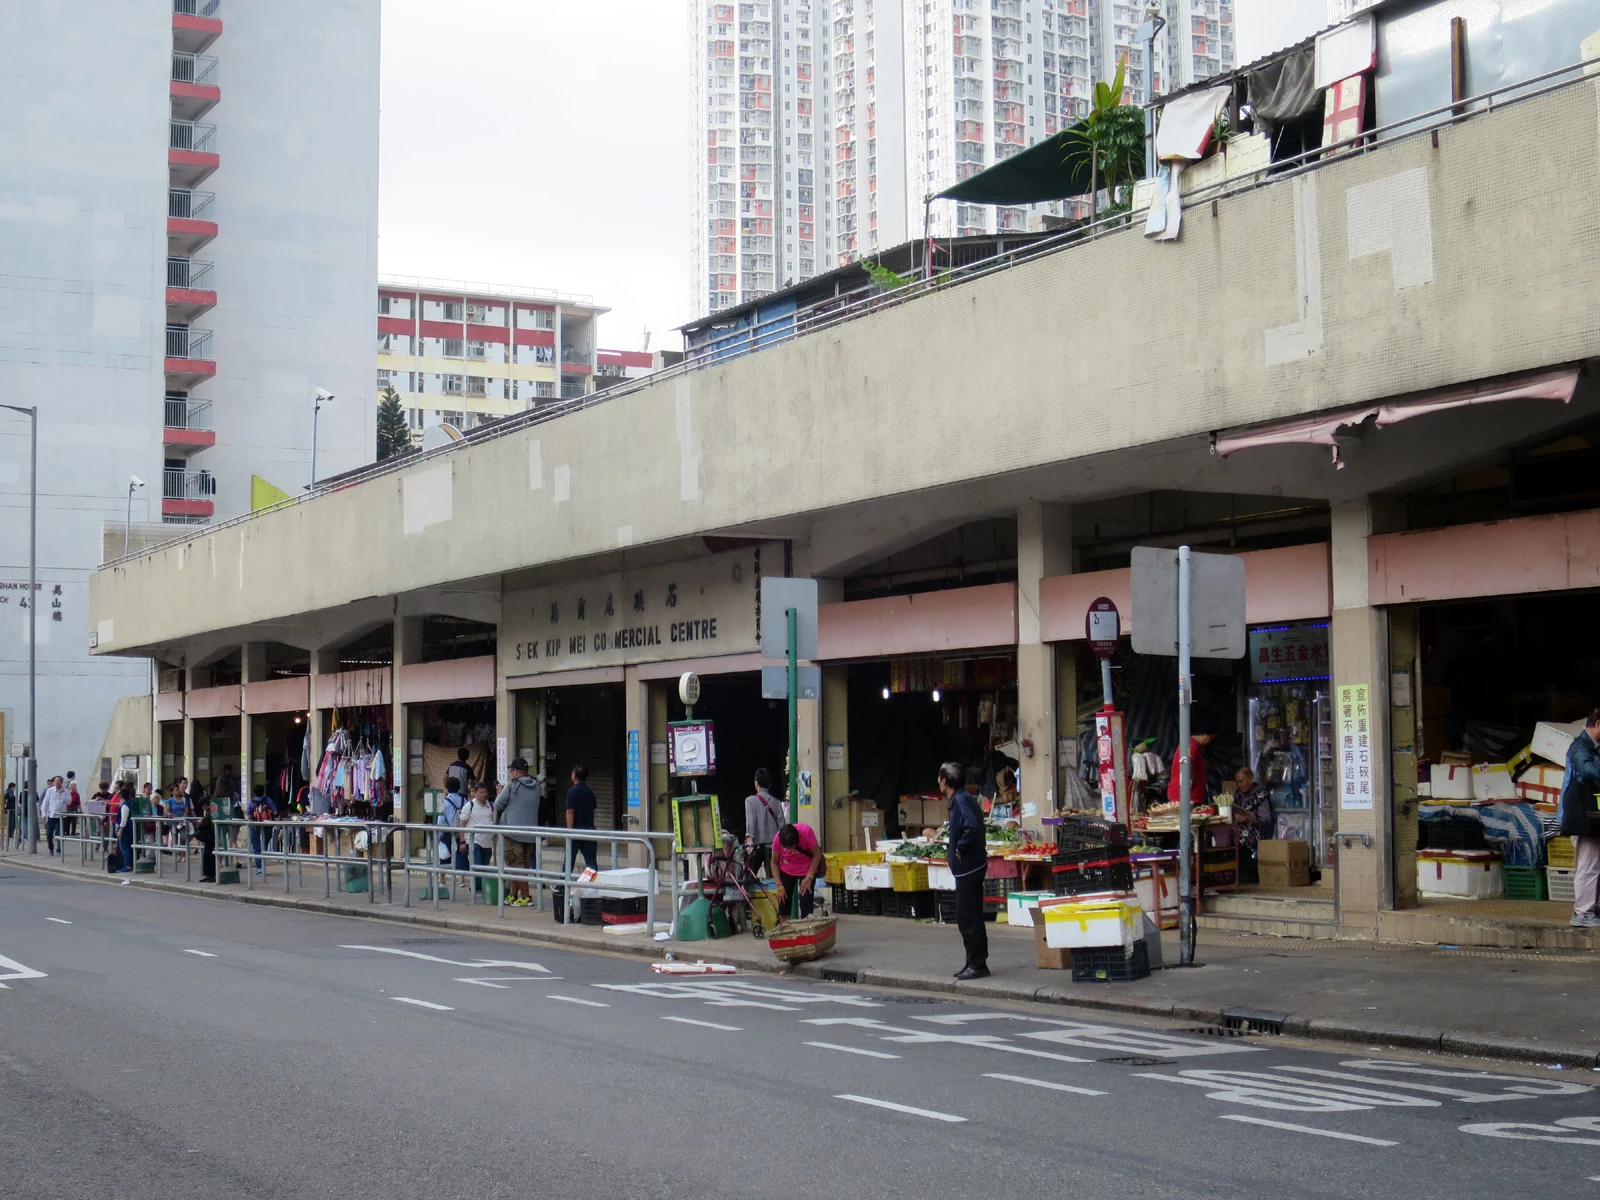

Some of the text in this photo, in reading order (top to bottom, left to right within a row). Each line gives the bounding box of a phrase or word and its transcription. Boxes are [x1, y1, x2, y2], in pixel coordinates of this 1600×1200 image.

[20, 583, 42, 591] HOSE
[546, 639, 561, 657] KIP
[569, 635, 586, 654] MEI
[670, 618, 717, 642] CENTRE
[1342, 688, 1356, 795] 房署不應再逃避
[1130, 1059, 1596, 1112] STOP
